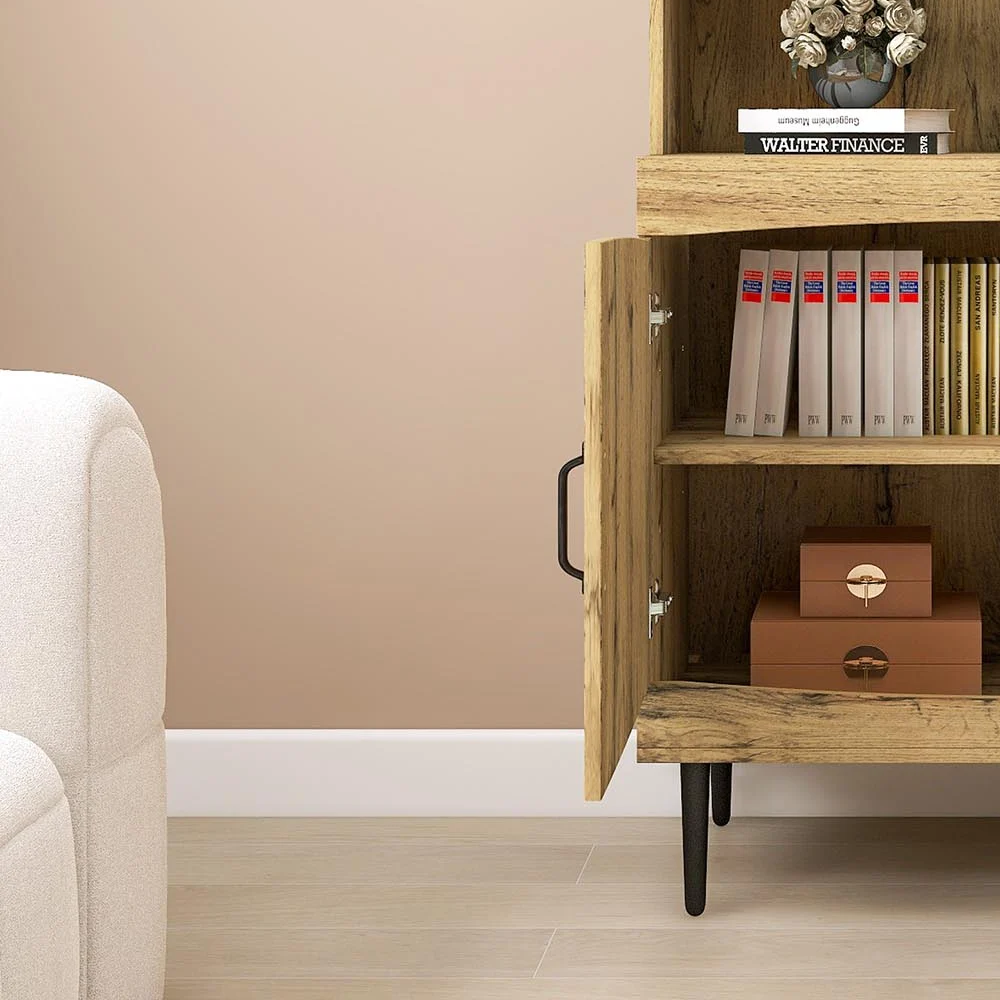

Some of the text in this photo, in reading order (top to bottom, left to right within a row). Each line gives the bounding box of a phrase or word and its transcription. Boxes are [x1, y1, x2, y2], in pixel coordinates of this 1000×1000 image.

[777, 116, 860, 127] Guggenheim Museum
[760, 137, 905, 153] WALTER FINANCE
